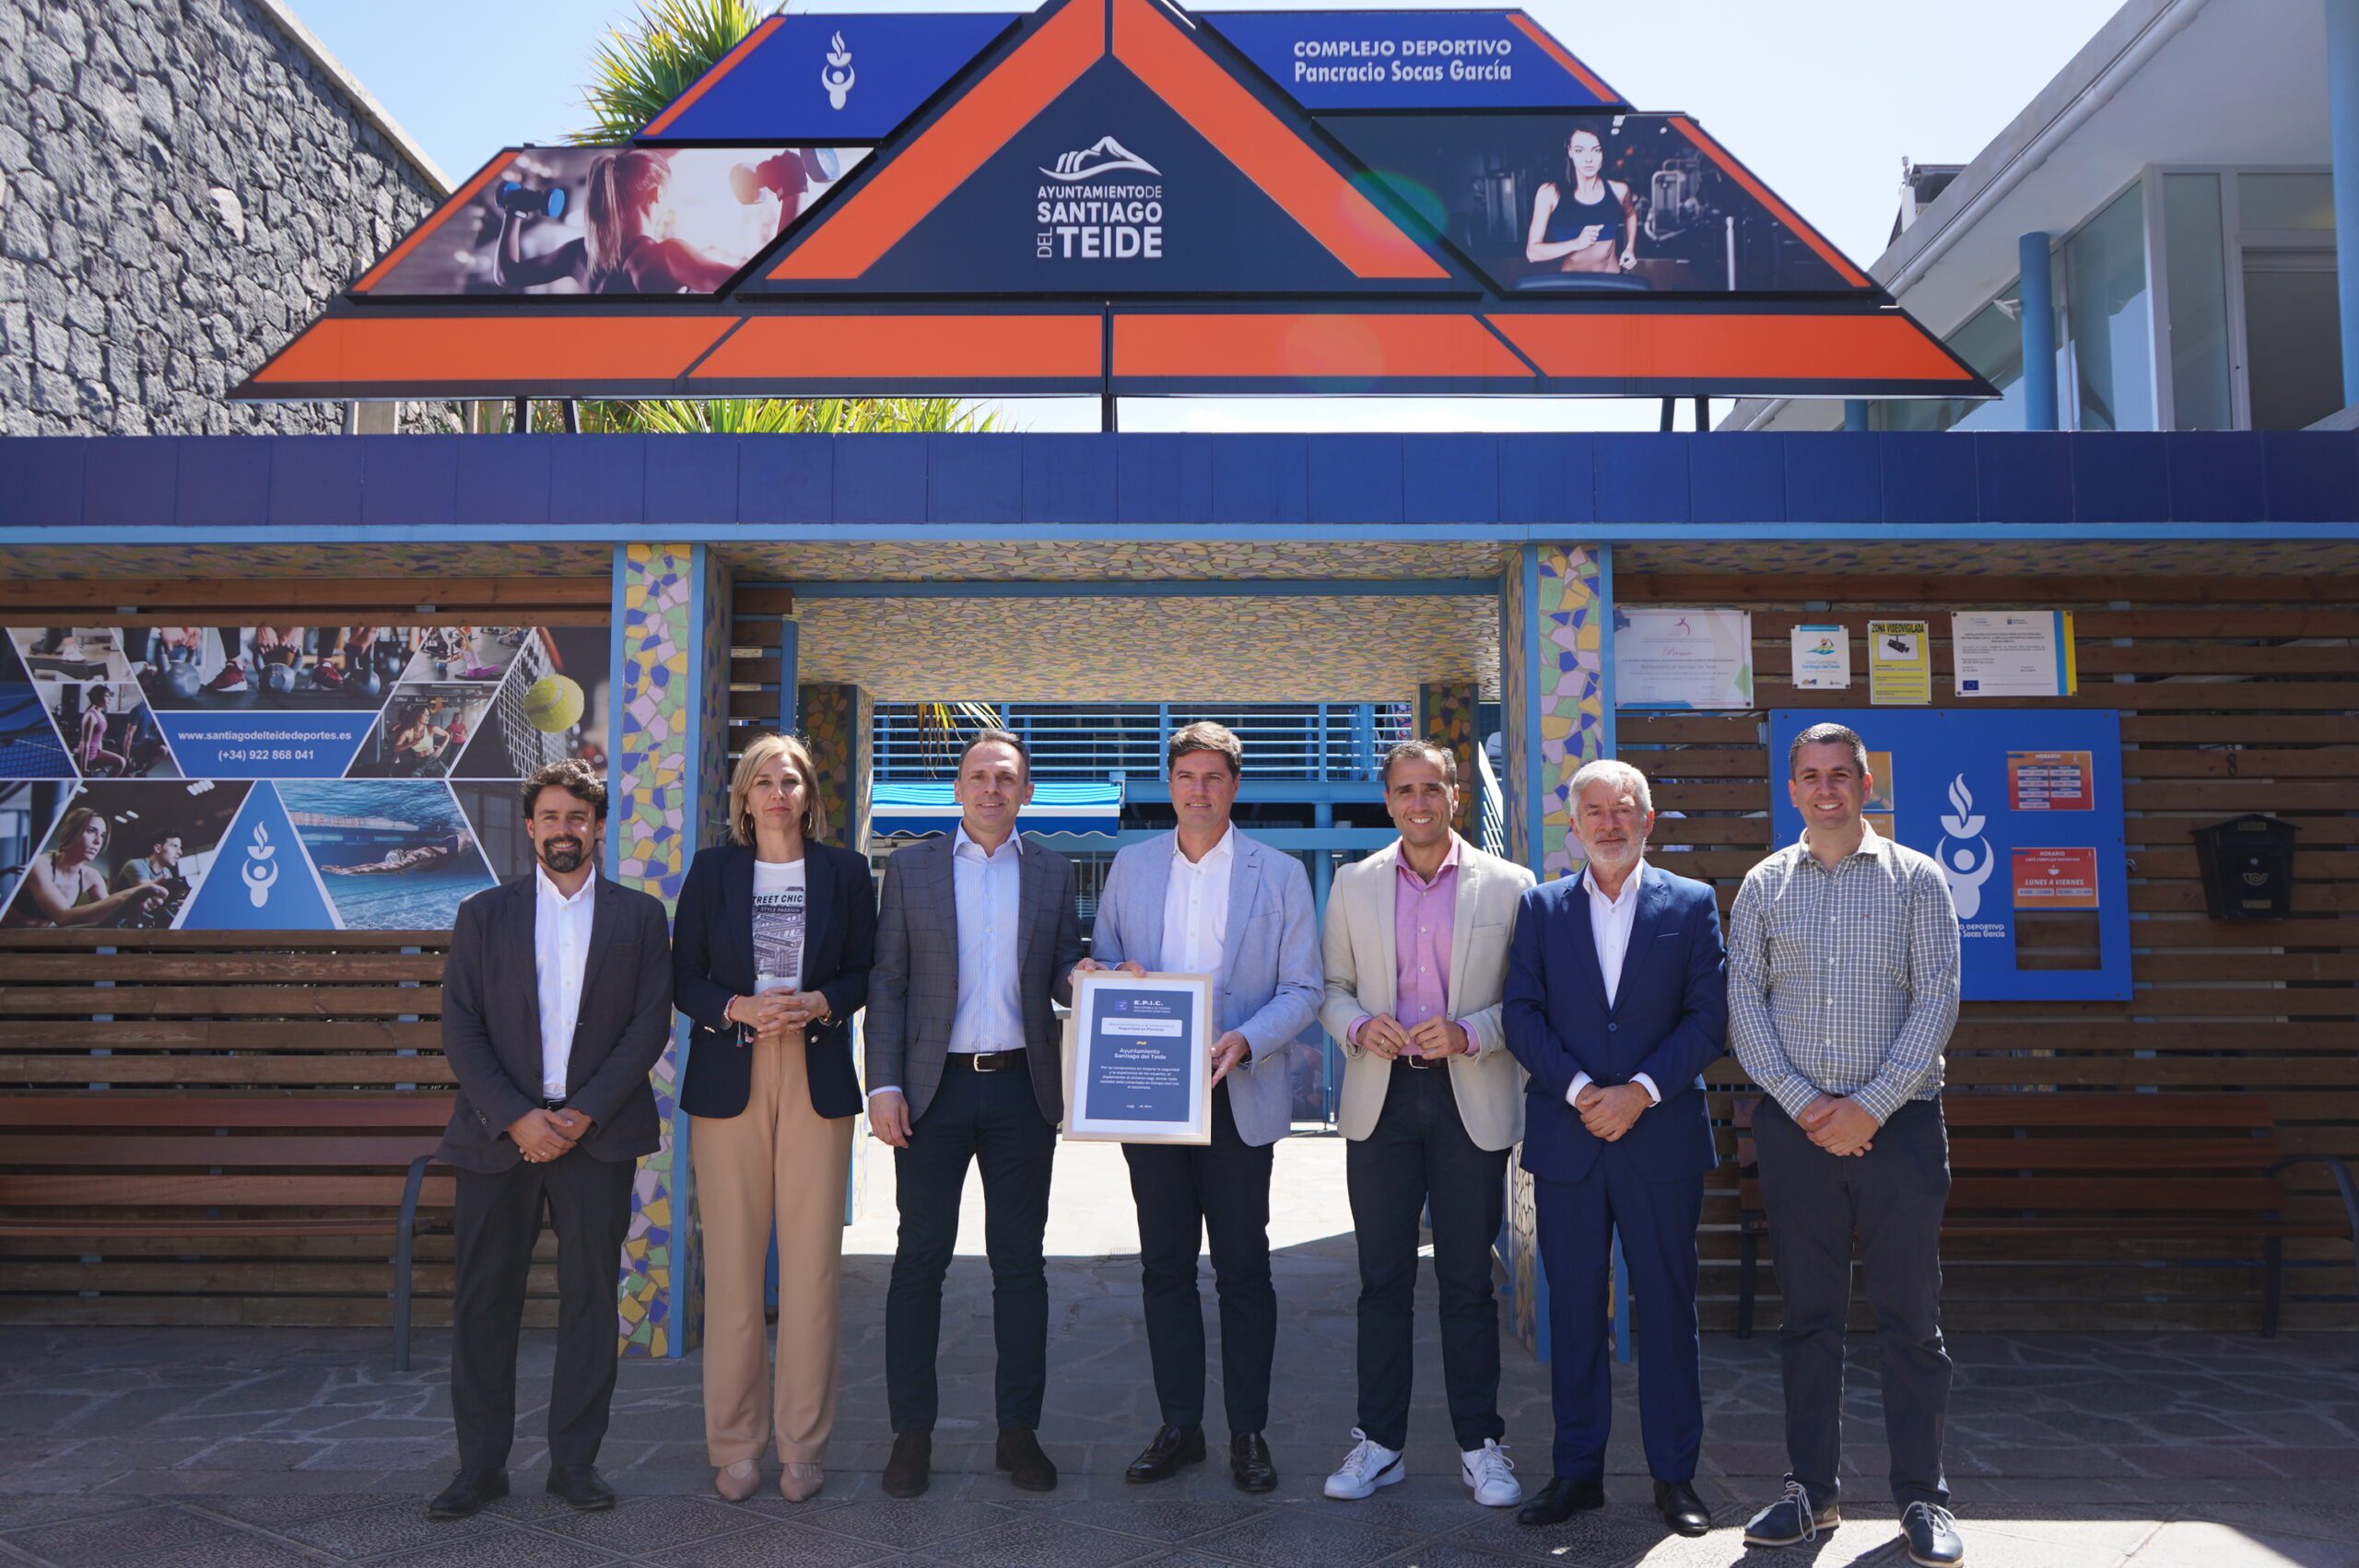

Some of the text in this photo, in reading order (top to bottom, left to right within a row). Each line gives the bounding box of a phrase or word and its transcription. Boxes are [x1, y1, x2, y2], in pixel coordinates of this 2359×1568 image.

[1294, 39, 1512, 57] COMPLEJO DEPORTIVO
[1294, 58, 1512, 83] Pancracio Socas García
[1037, 202, 1162, 223] SANTIAGO
[1037, 226, 1162, 258] DEL TEIDE
[1872, 623, 1924, 633] ZONA VIDEOVIGILADA
[178, 731, 351, 742] www.santiagodelteidedeportes.es
[218, 750, 314, 762] (+34) 922 868 041
[752, 895, 779, 904] TREET
